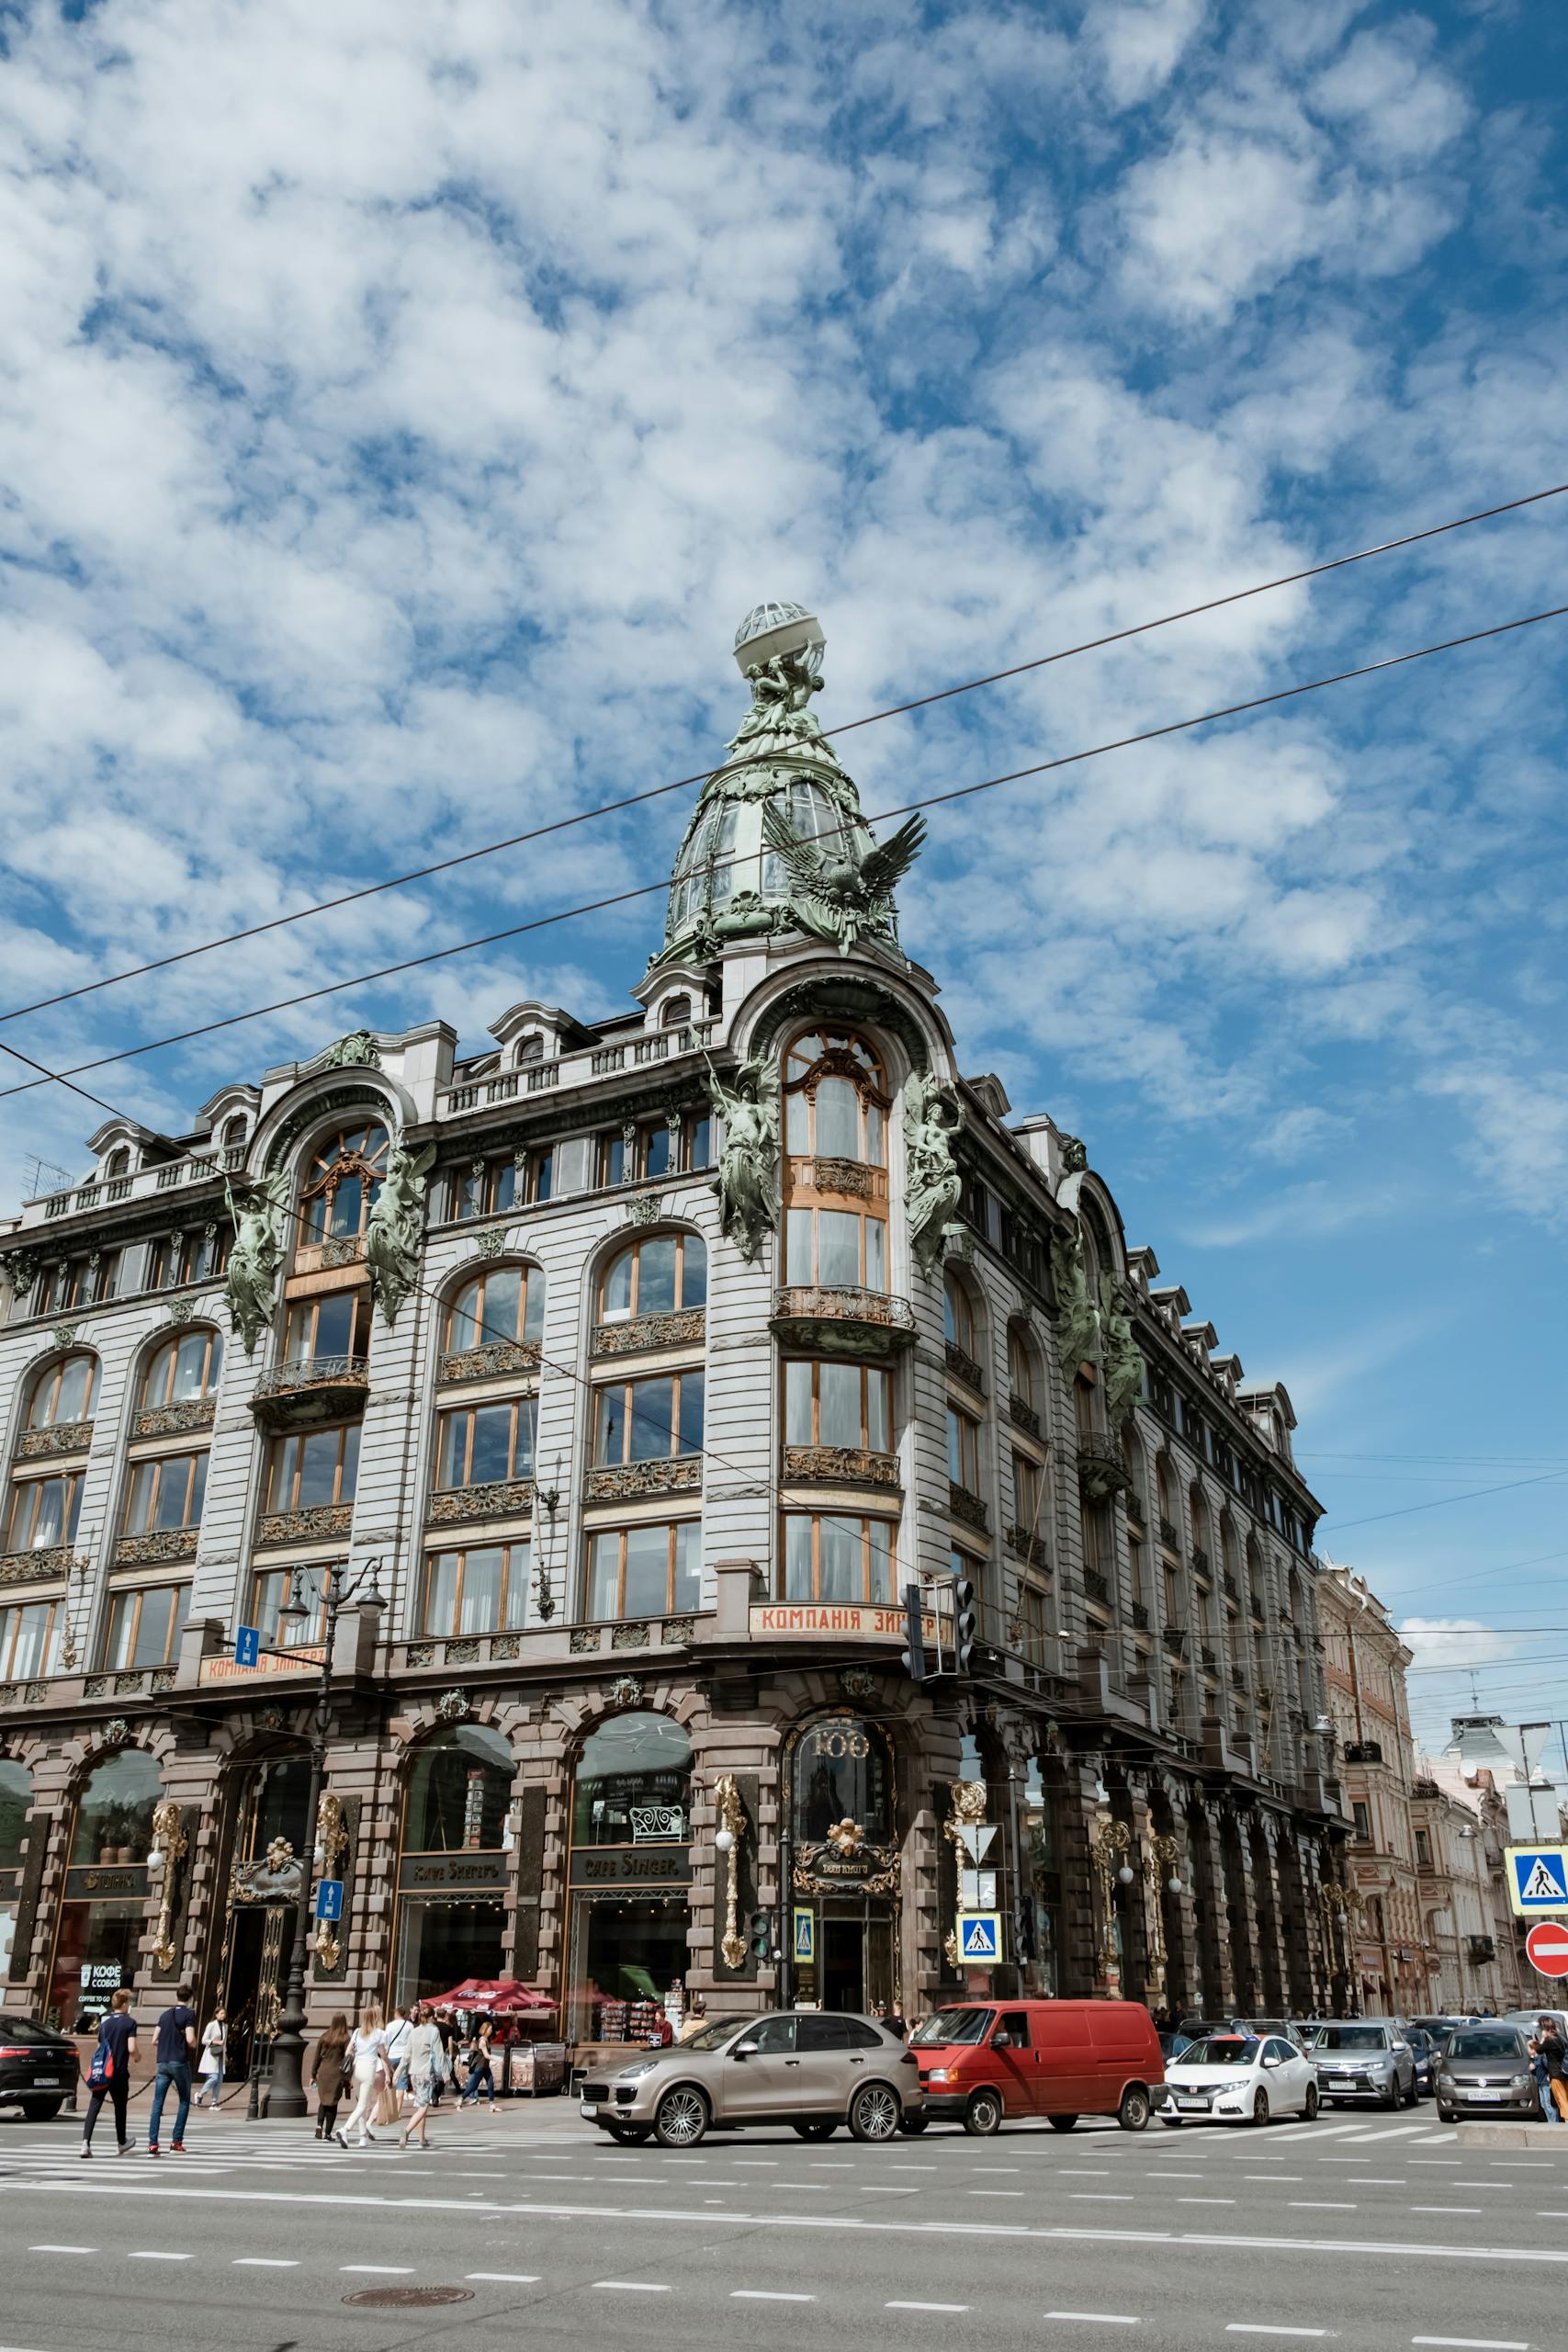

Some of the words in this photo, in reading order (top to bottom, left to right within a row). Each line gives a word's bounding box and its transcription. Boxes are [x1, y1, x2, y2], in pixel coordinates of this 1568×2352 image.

[762, 1609, 861, 1630] КОМПАНІЯ
[93, 1965, 122, 1978] КОФЕ
[96, 1977, 121, 1988] СОБОЙ
